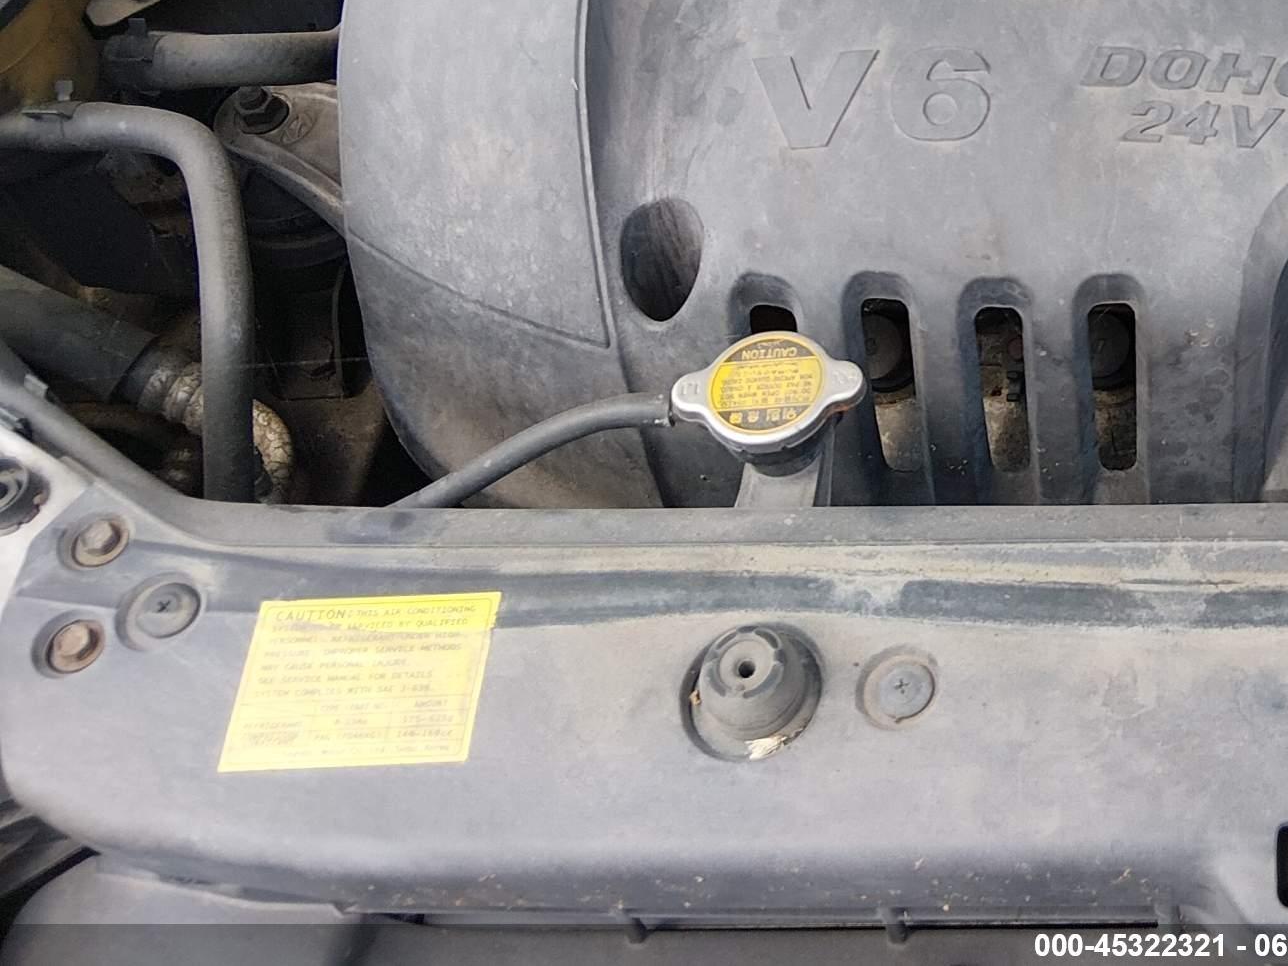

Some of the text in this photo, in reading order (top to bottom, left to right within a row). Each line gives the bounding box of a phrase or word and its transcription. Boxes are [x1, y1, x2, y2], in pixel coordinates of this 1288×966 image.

[752, 47, 991, 150] V6
[1122, 100, 1285, 149] 24V
[741, 346, 797, 361] CAUTION
[416, 617, 468, 627] QUALIFIED
